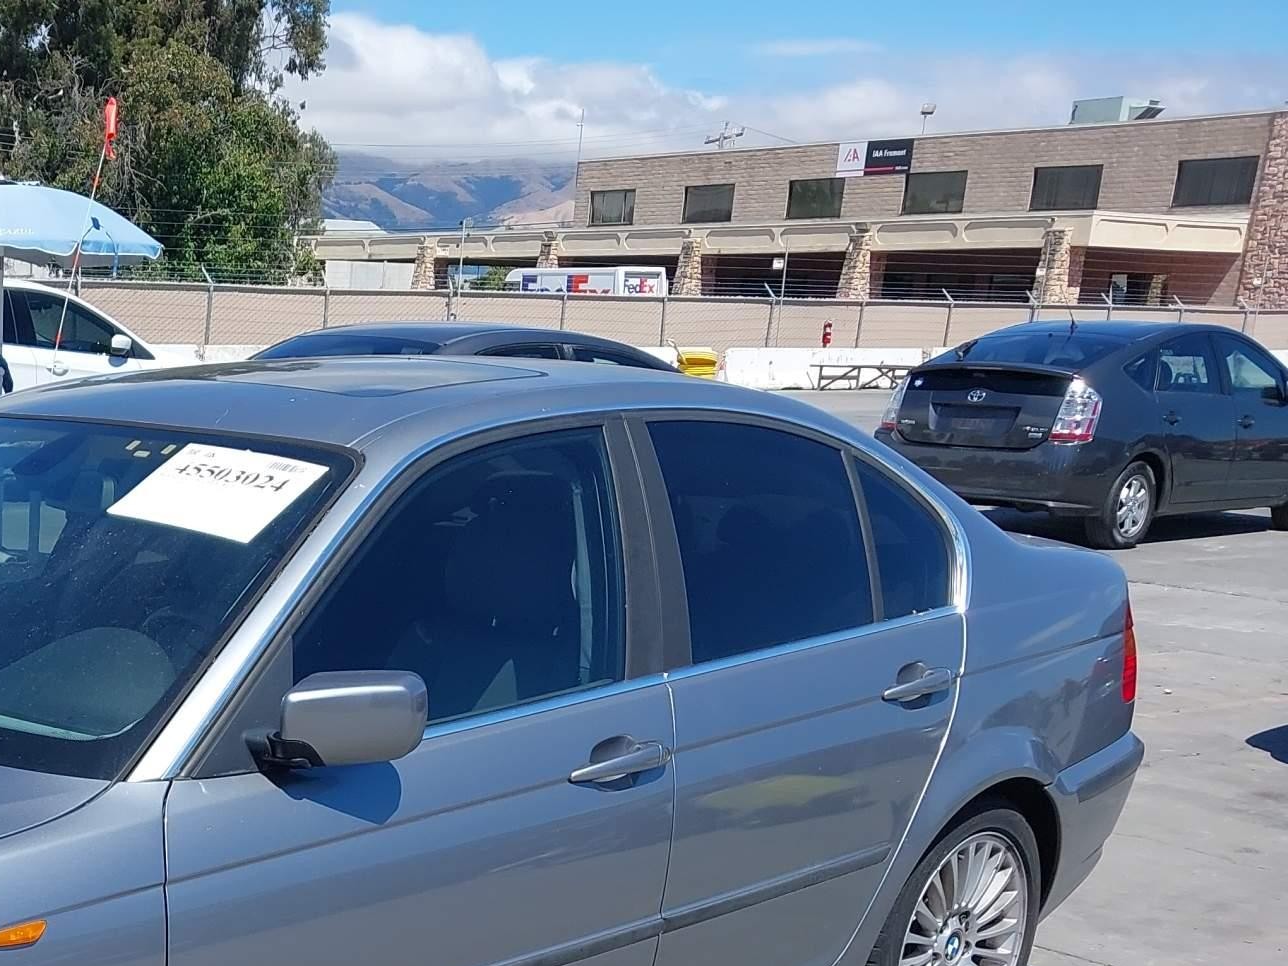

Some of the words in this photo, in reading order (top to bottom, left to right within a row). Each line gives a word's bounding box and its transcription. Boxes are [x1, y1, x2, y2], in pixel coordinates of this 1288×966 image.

[872, 149, 883, 158] IAA
[623, 277, 655, 294] FedEx
[175, 463, 290, 492] 45503024
